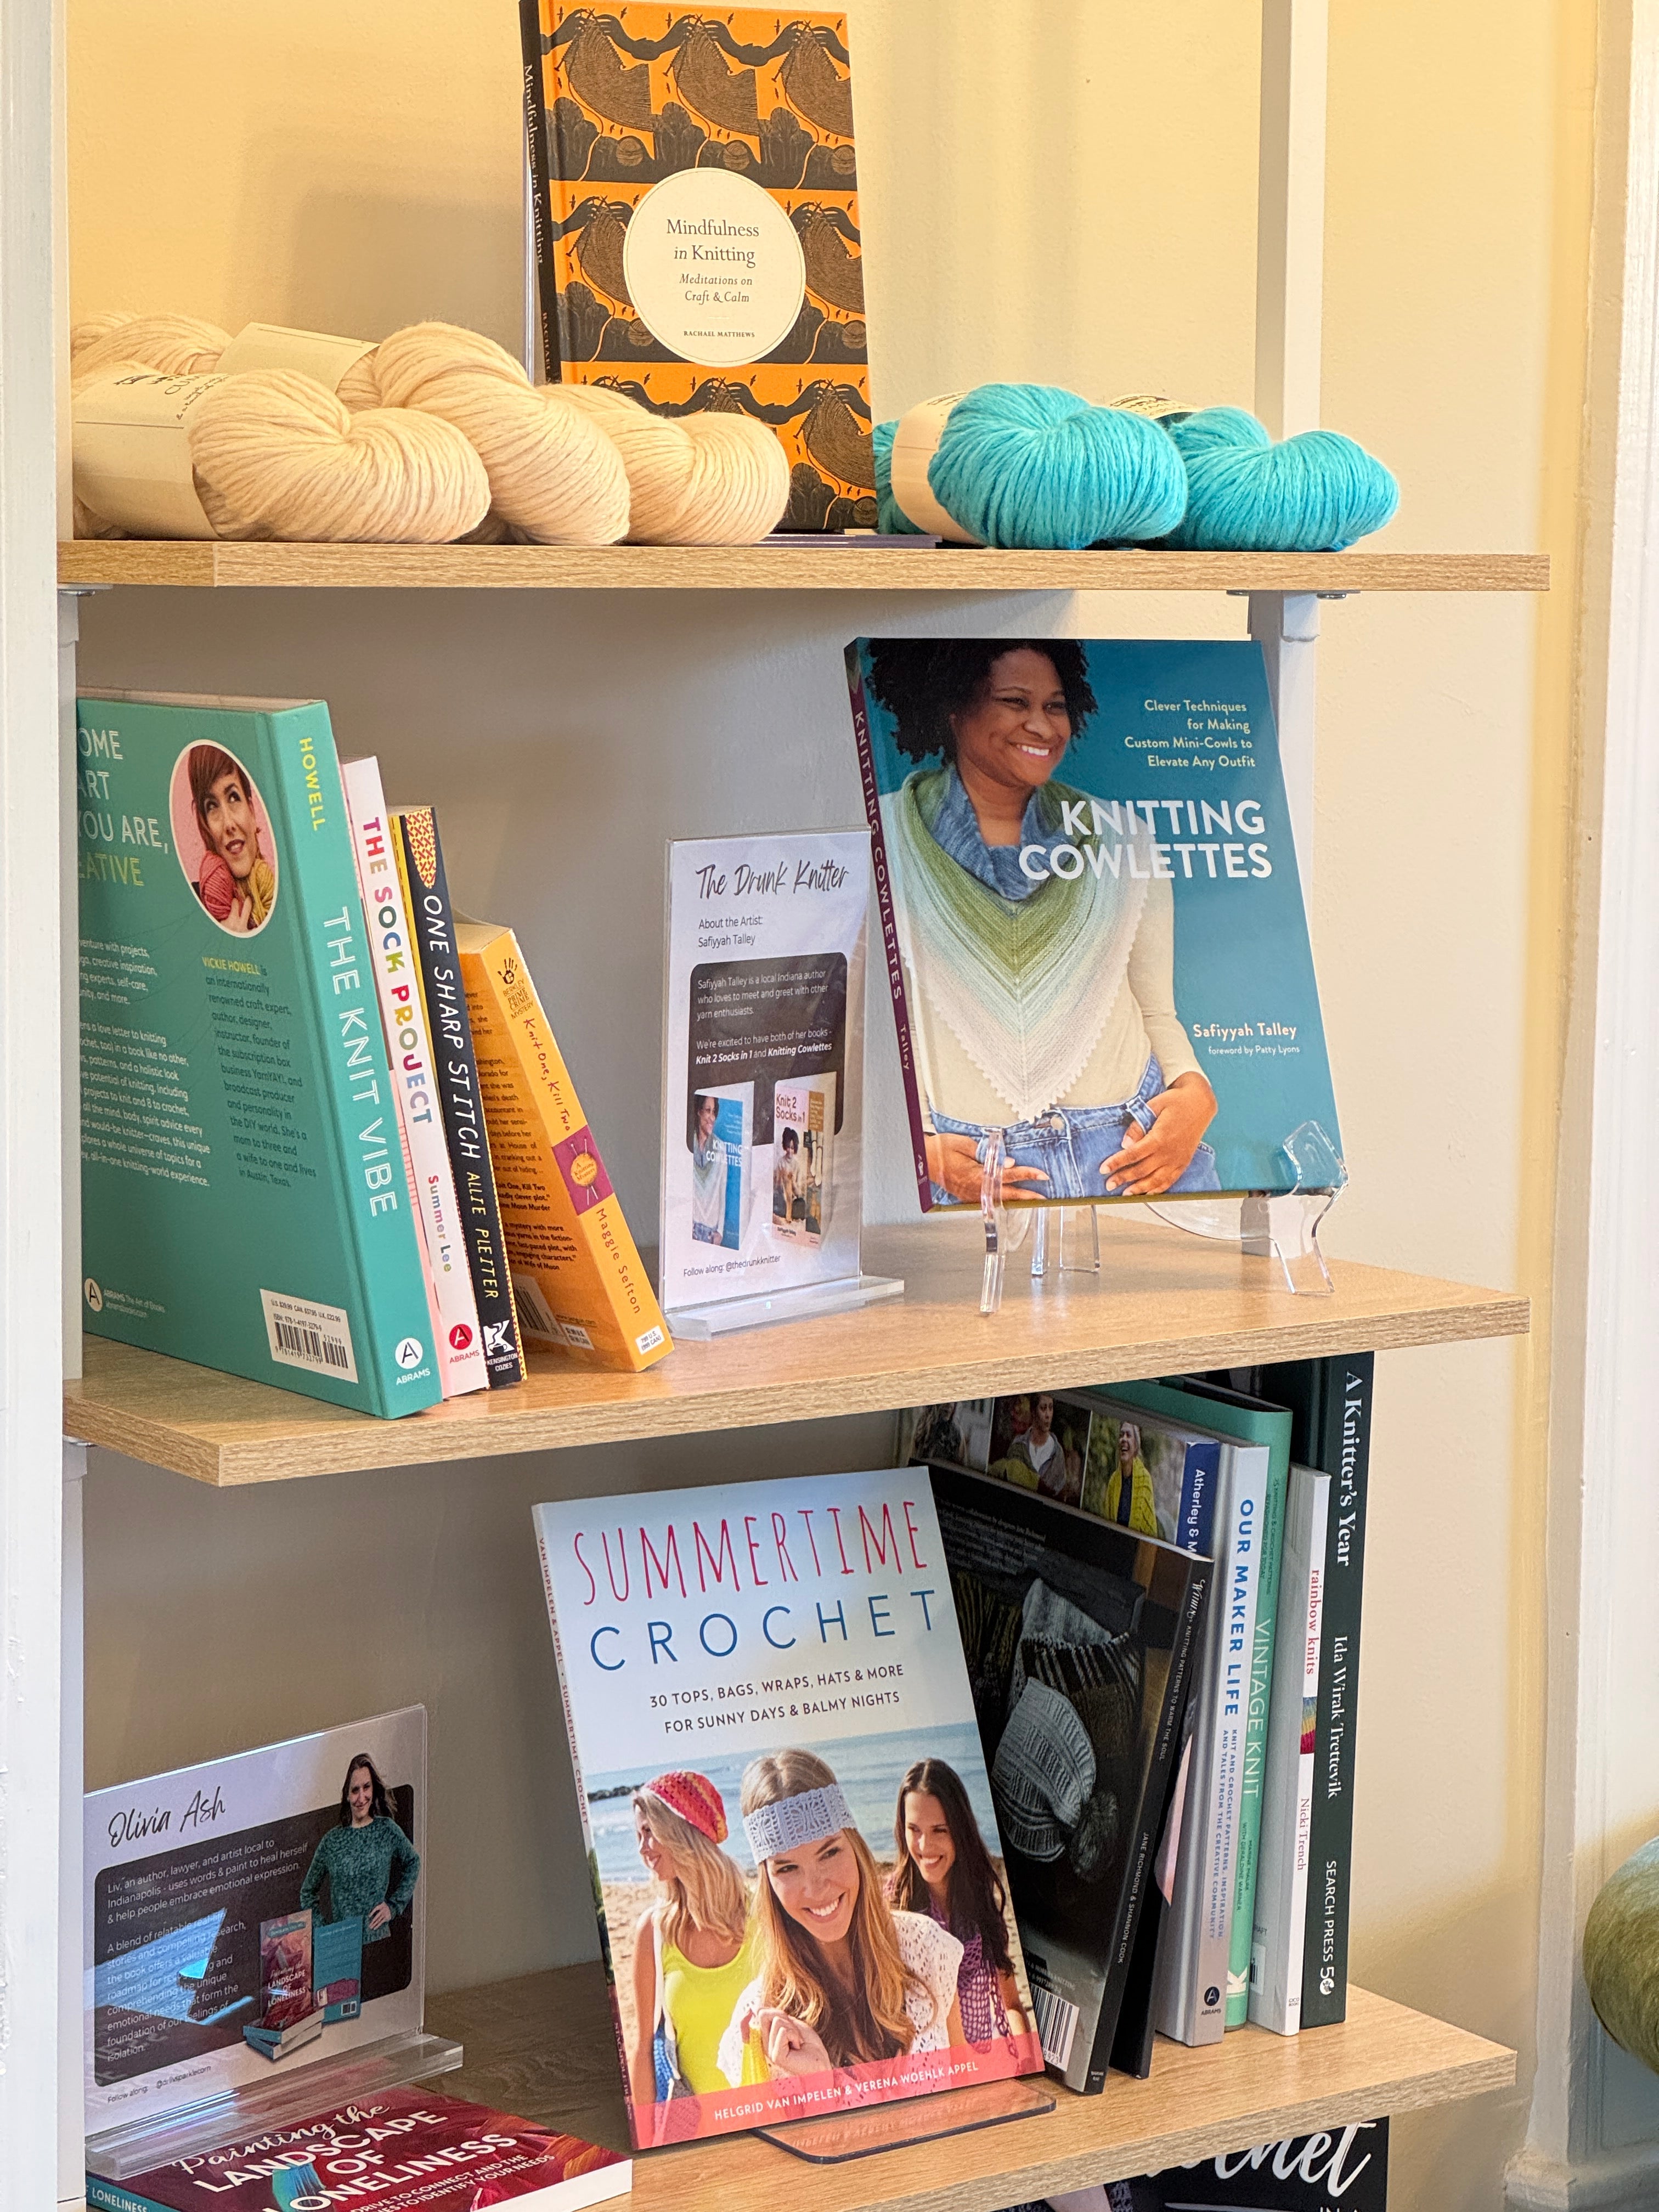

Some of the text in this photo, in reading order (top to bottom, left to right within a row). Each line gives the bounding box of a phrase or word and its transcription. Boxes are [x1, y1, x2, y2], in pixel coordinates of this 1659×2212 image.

[667, 219, 759, 236] Mindfulness
[674, 245, 755, 268] in Knitting
[679, 274, 737, 285] Meditations
[685, 290, 749, 305] Craft & Calm
[1144, 699, 1246, 715] Clever Techniques
[1187, 719, 1250, 735] for Making
[1125, 737, 1252, 748] Custom Mini-Cowls to
[1148, 755, 1255, 771] Elevate Any Outfit
[299, 737, 326, 832] HOWELL
[1061, 800, 1265, 836] KNITTING
[854, 710, 901, 1000] KNITTING COWLETTES
[1019, 843, 1272, 880] COWLETTES
[696, 859, 849, 899] The Drunk Knitter
[698, 915, 763, 929] About the Artist:
[698, 934, 755, 949] Safiyyah Talley
[202, 957, 261, 975] VICKIE HOWELL
[363, 817, 433, 1124] THE SOCK PROJECT
[503, 979, 524, 997] BERKLEY
[508, 988, 528, 1004] PRIME
[510, 994, 529, 1010] CRIME
[424, 895, 480, 1159] ONE SHARP STITCH
[511, 1001, 534, 1019] MYSTERY
[900, 1024, 910, 1070] Talley
[1193, 1022, 1296, 1042] Safiyyah Talley
[1209, 1044, 1300, 1057] foreword by Patty Lyons
[324, 906, 397, 1218] THE KNIT VIBE
[696, 1056, 711, 1065] Knit
[719, 1052, 740, 1061] Socks
[741, 1051, 747, 1059] in
[768, 1047, 796, 1057] Knitting
[798, 1042, 832, 1053] Cowlettes
[523, 1018, 571, 1131] Knit One, Kill Two
[428, 1175, 452, 1273] Summer Lee
[466, 1172, 499, 1299] ALLIE PLEITER
[596, 1209, 640, 1313] Maggie Sefton
[684, 1255, 781, 1277] Follow along: @thedrunkknitter
[396, 1368, 430, 1385] ABRAMS
[449, 1350, 479, 1363] ABRAMS
[487, 1353, 518, 1365] KENSINGTON
[495, 1363, 512, 1372] COZIES
[1337, 1372, 1362, 1567] A Knitter's Year
[1187, 1468, 1205, 1537] Atherley &
[574, 1500, 927, 1606] SUMMERTIME
[1224, 1499, 1254, 1716] OUR MAKER LIFE
[1305, 1570, 1322, 1675] rainbow knits
[590, 1589, 935, 1671] CROCHET
[542, 1565, 555, 1614] IMPELEN
[553, 1627, 563, 1662] APPEL
[562, 1684, 578, 1761] SUMMERTIME
[575, 1769, 588, 1825] CROCHET
[650, 1664, 904, 1707] 30 TOPS, BAGS, WRAPS, HATS & MORE
[1247, 1617, 1272, 1733] VINTAGE
[664, 1691, 900, 1733] FOR SUNNY DAYS & BALMY NIGHTS
[1327, 1635, 1347, 1799] Ida Wirak Trettevik
[1243, 1740, 1261, 1798] KNIT
[108, 1786, 225, 1848] Olivia Ash
[1297, 1797, 1310, 1871] Nicki Trench
[1141, 1832, 1149, 1851] JANE
[108, 1839, 274, 1894] Liv, an author, lawyer, and artist local to
[1132, 1853, 1145, 1893] RICHMOND
[1122, 1904, 1134, 1940] SHANNON
[1323, 1860, 1337, 1960] SEARCH PRESS
[1118, 1943, 1126, 1963] COOK
[715, 2061, 978, 2120] HELGRID VAN IMPELEN & VERENA WOEHLK APPEL
[171, 2103, 392, 2175] Painting the
[194, 2110, 449, 2193] LANDSCAPE
[325, 2149, 386, 2175] OF
